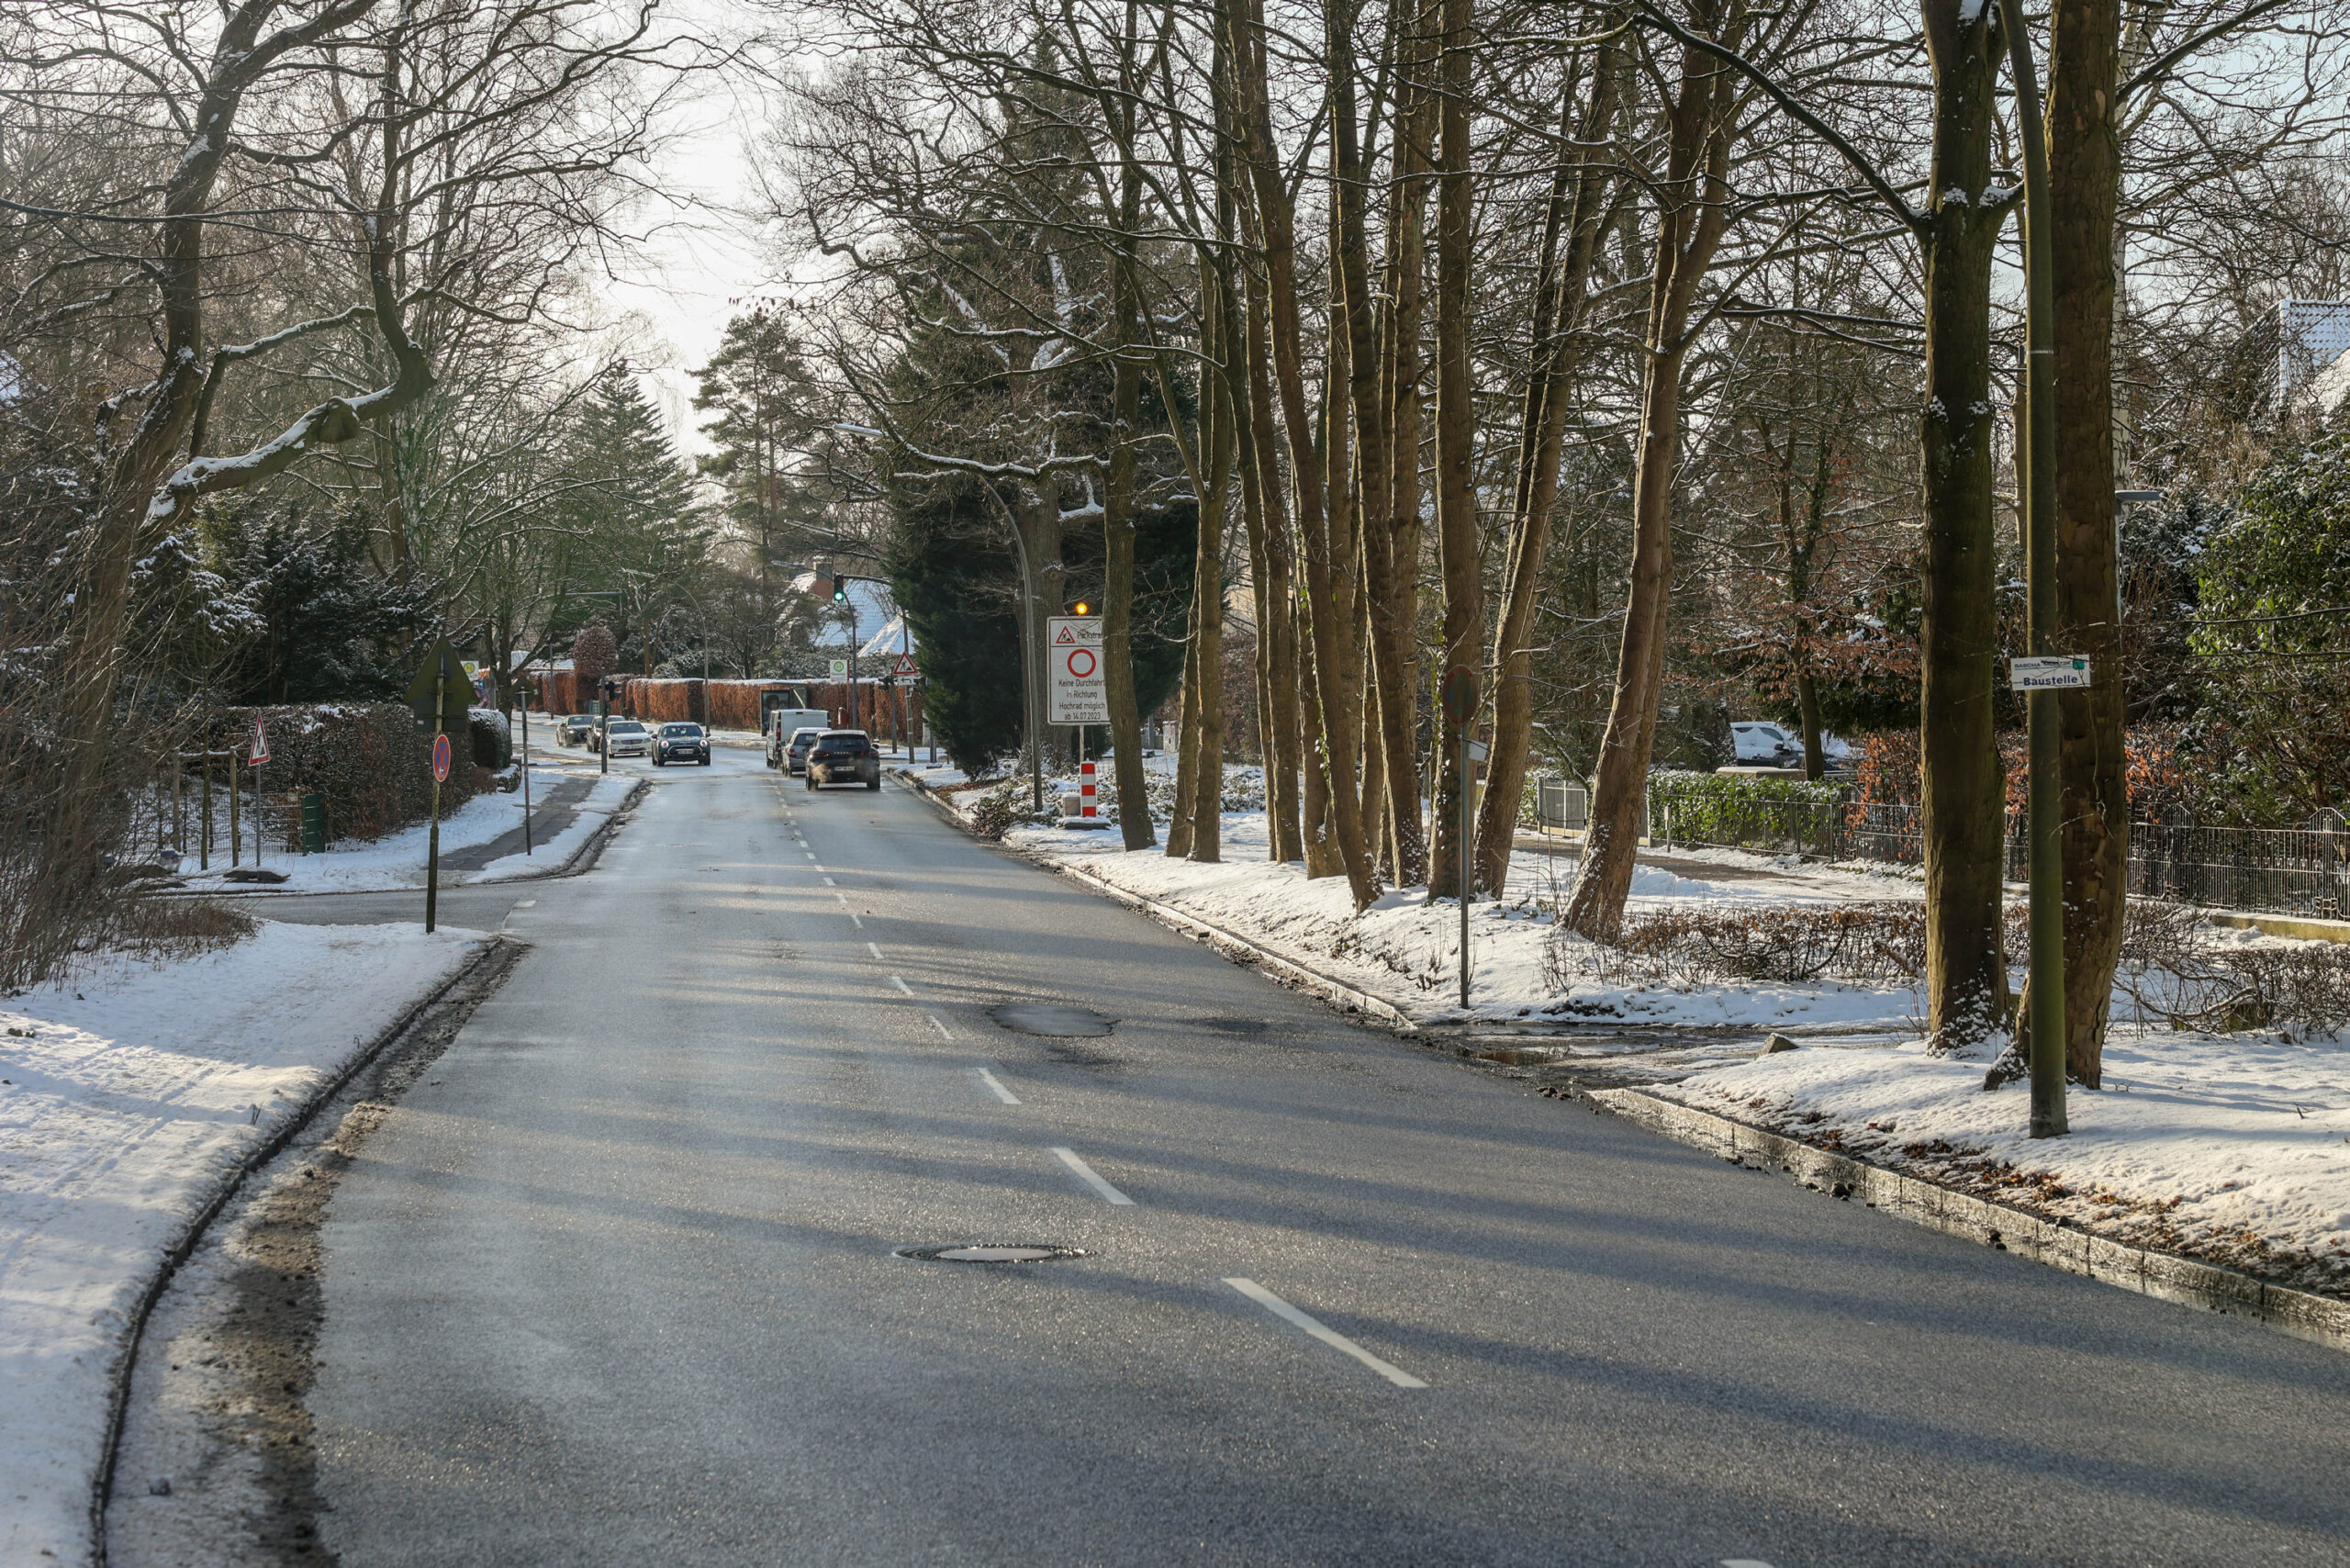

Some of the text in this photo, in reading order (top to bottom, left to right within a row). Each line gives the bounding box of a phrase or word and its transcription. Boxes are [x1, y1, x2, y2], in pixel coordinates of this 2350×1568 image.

[1058, 678, 1105, 687] Keine Durchfahrt
[2023, 675, 2078, 686] Baustelle
[1066, 690, 1098, 700] in Richtung
[1058, 701, 1105, 711] Hochrad möglich
[1064, 711, 1101, 720] ab 14.07.2023
